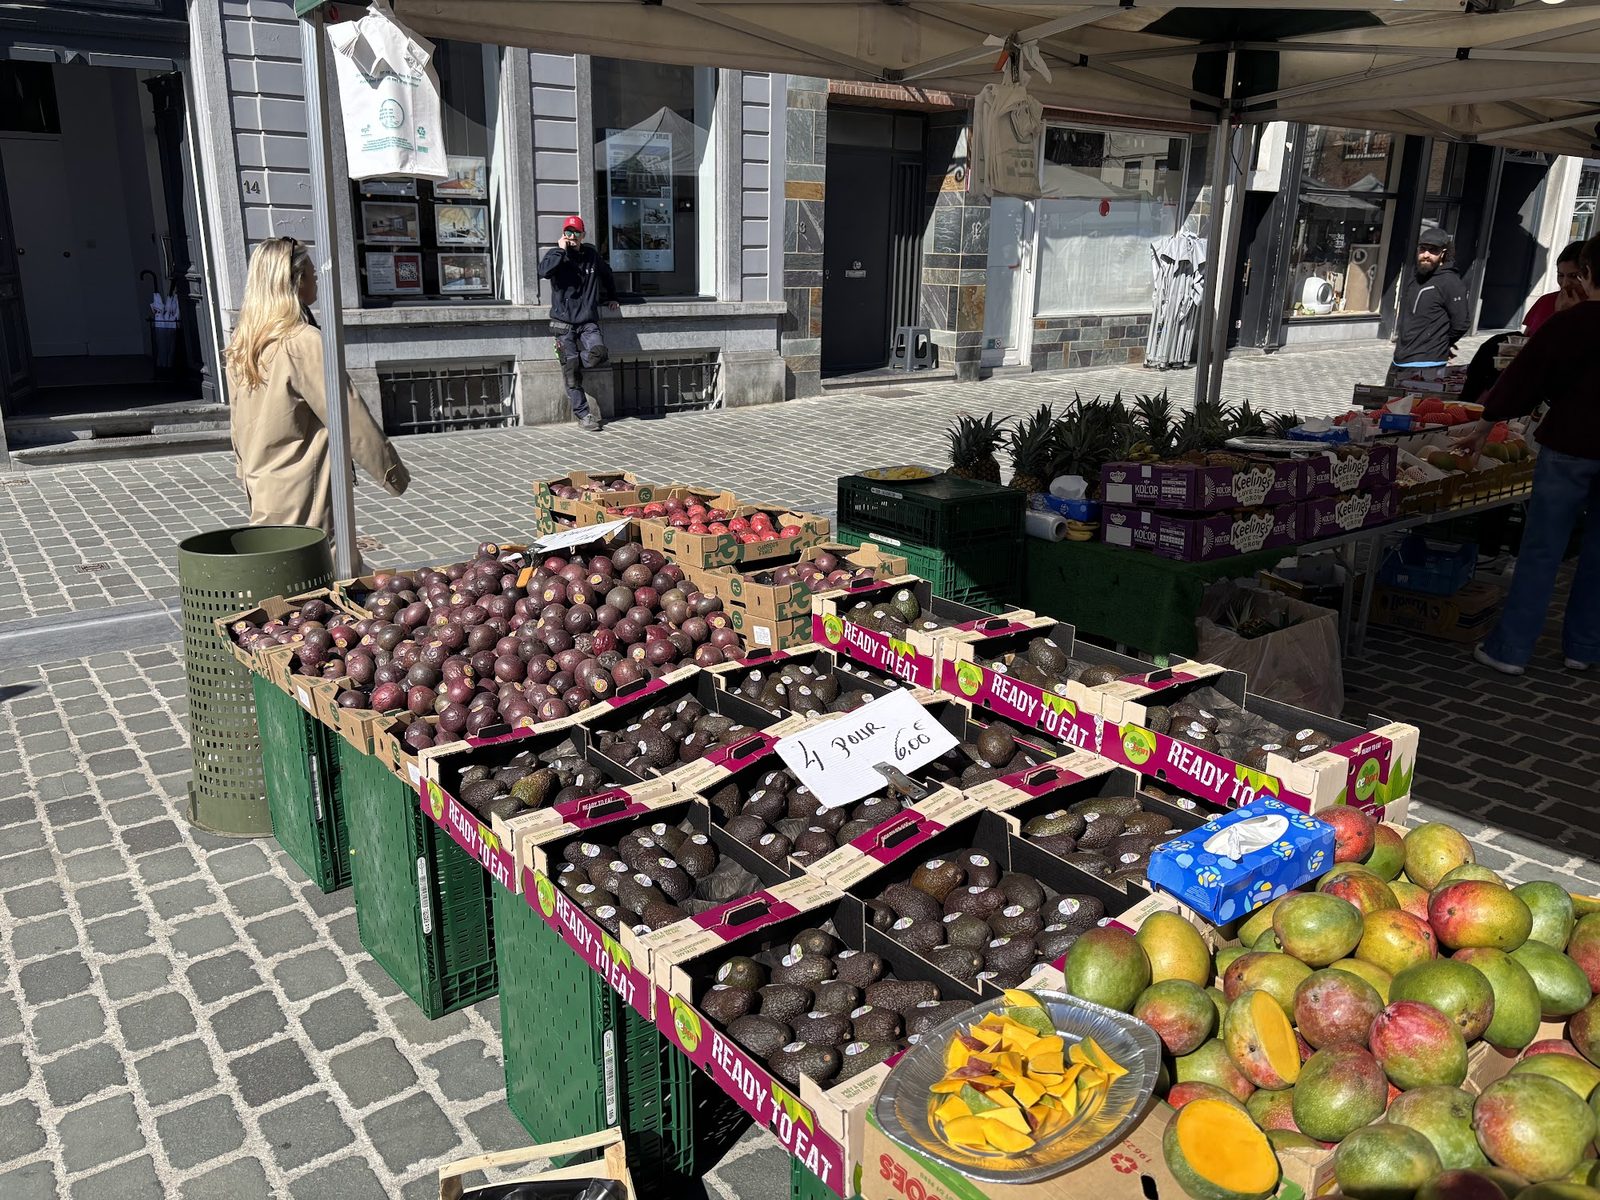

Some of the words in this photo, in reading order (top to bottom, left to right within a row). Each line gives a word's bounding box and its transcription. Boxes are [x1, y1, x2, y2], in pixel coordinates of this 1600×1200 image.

[243, 180, 261, 195] 14
[1234, 470, 1271, 496] Keelings
[1232, 518, 1270, 541] Keelings
[844, 620, 879, 658] READY
[881, 645, 895, 668] TO
[895, 656, 919, 683] EAT
[991, 673, 1038, 717] READY
[1041, 703, 1059, 732] TO
[1057, 717, 1089, 748] EAT
[797, 740, 825, 771] 4
[1167, 740, 1229, 793] READY
[1232, 777, 1256, 809] TO
[582, 801, 598, 811] READY
[604, 797, 613, 805] EAT
[449, 798, 477, 849] READY
[478, 836, 490, 867] TO
[491, 852, 509, 888] EAT
[556, 890, 592, 954] READY
[594, 940, 609, 977] TO
[611, 962, 636, 1006] EAT
[711, 1032, 767, 1113] READY
[770, 1097, 793, 1145] TO
[794, 1130, 832, 1184] EAT
